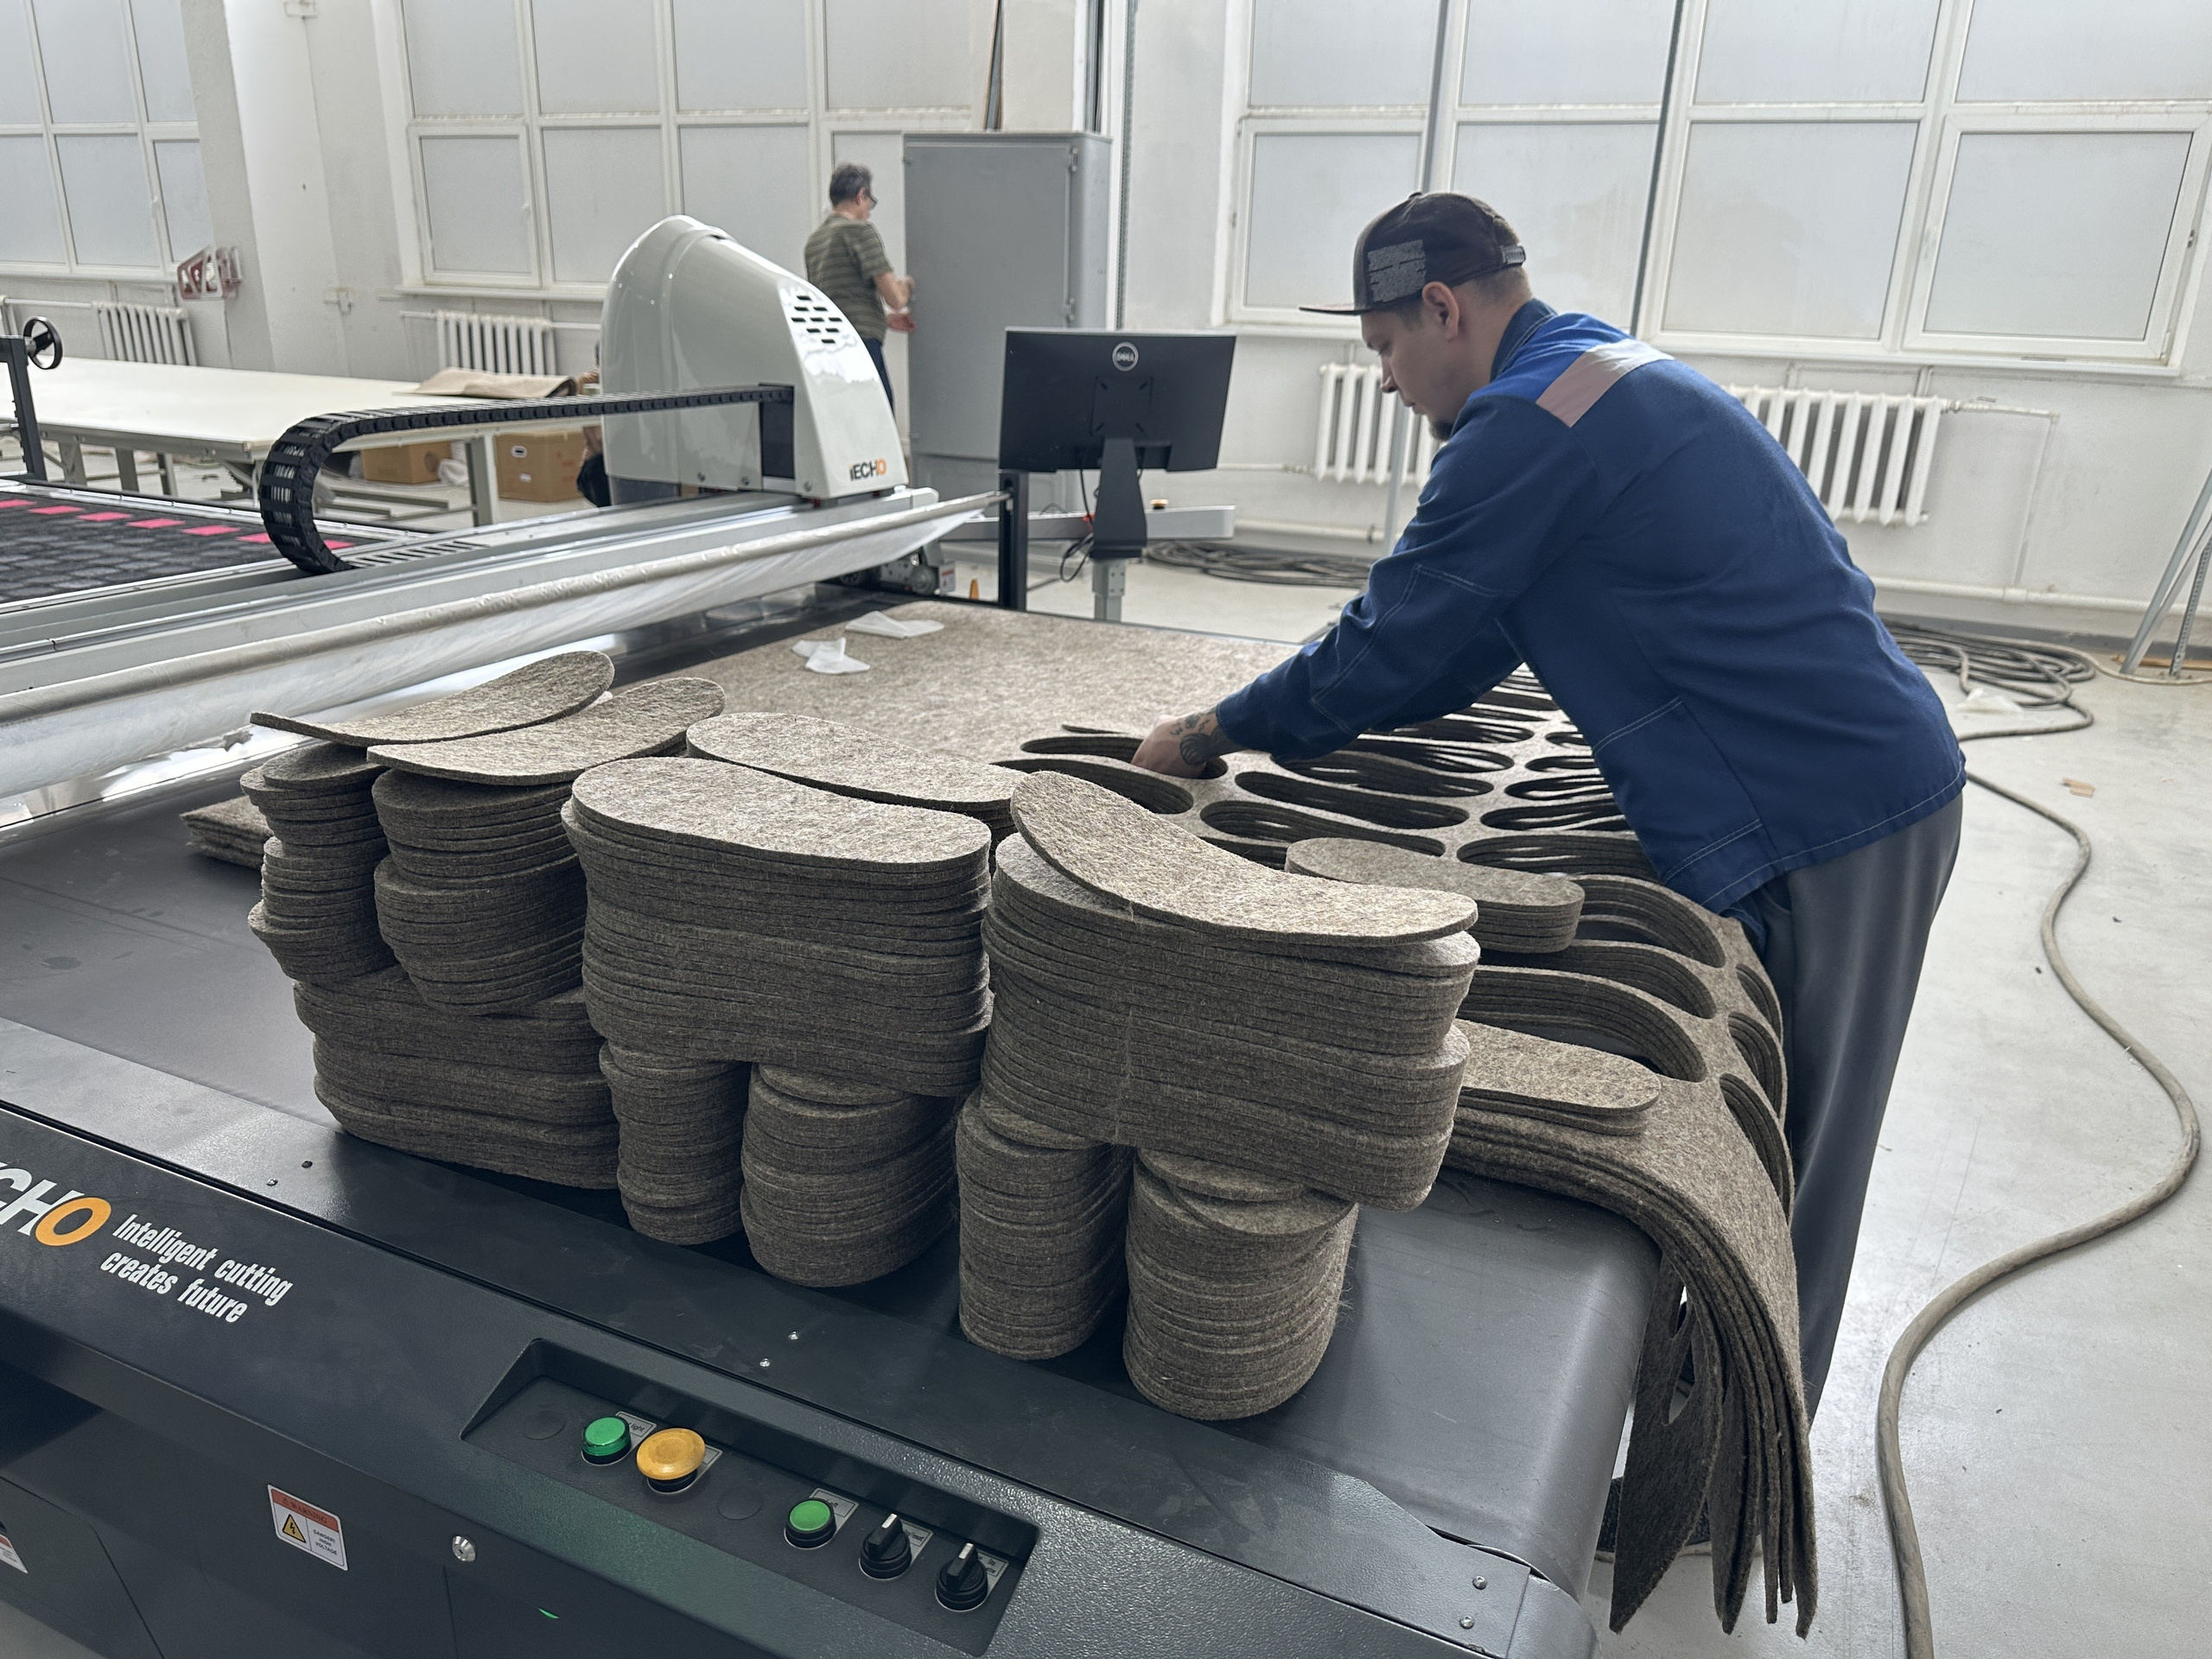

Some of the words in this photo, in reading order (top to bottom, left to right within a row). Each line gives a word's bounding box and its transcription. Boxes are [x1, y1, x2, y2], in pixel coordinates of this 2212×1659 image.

[112, 1214, 219, 1272] Intelligent
[214, 1259, 294, 1306] cutting
[100, 1252, 179, 1294] creates
[177, 1278, 248, 1323] future
[290, 1501, 327, 1524] WARNING
[315, 1541, 338, 1555] VOLTAGE
